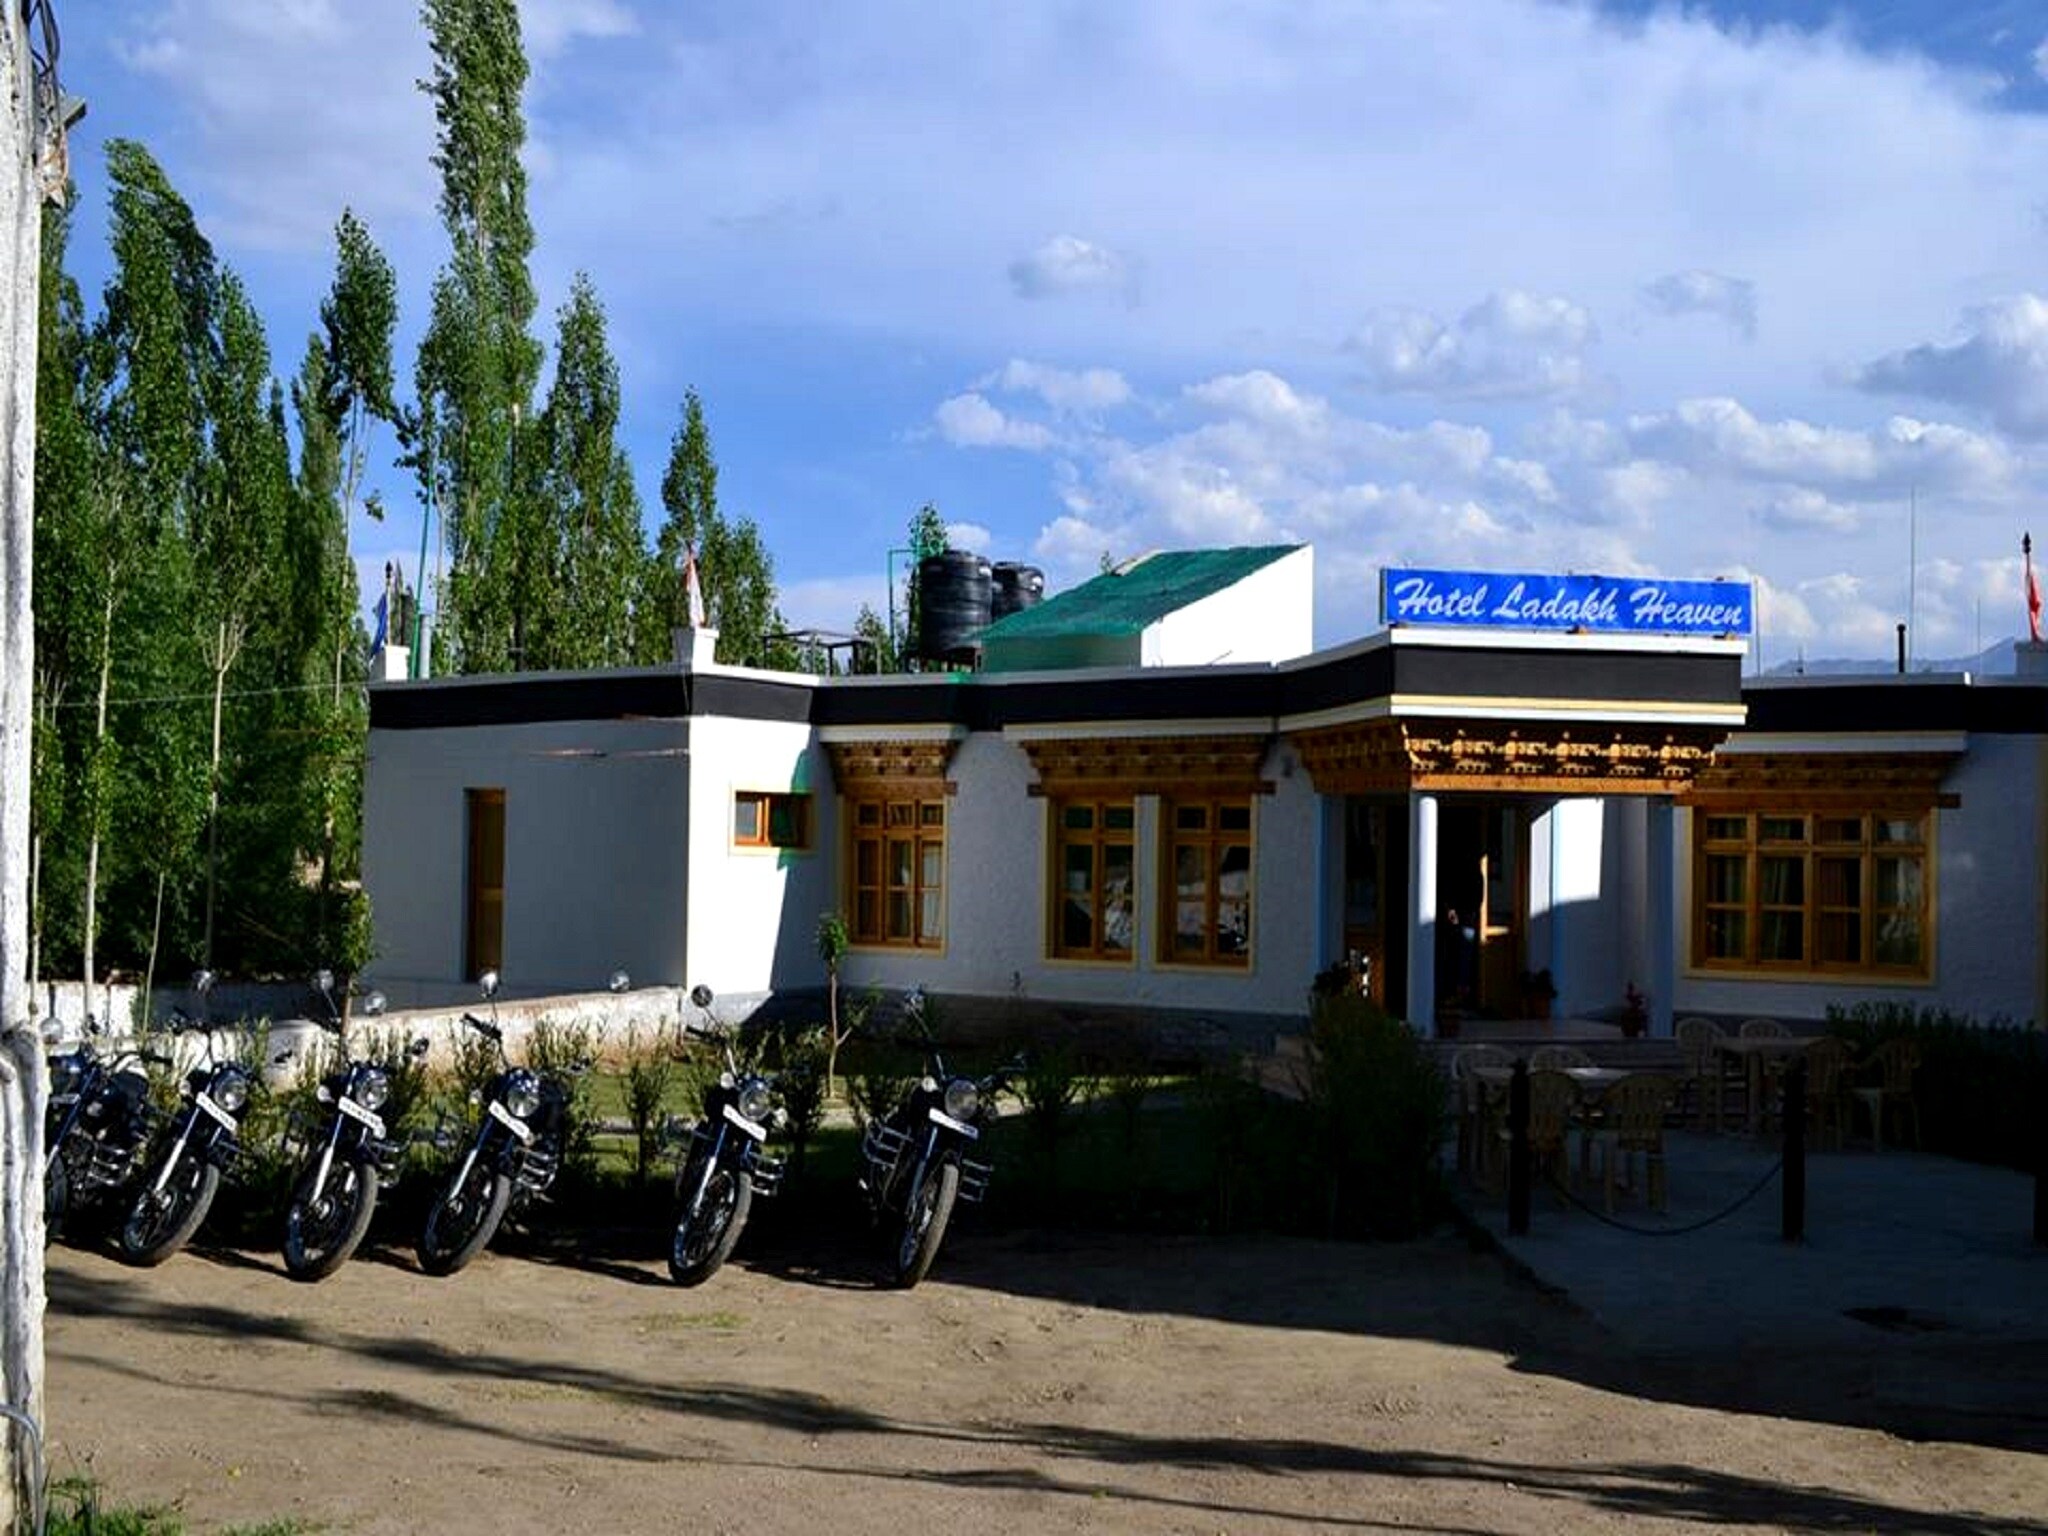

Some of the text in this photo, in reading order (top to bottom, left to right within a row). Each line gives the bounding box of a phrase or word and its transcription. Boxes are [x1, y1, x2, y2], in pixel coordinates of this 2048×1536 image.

[1393, 577, 1743, 626] Hotel Ladakh Heaven
